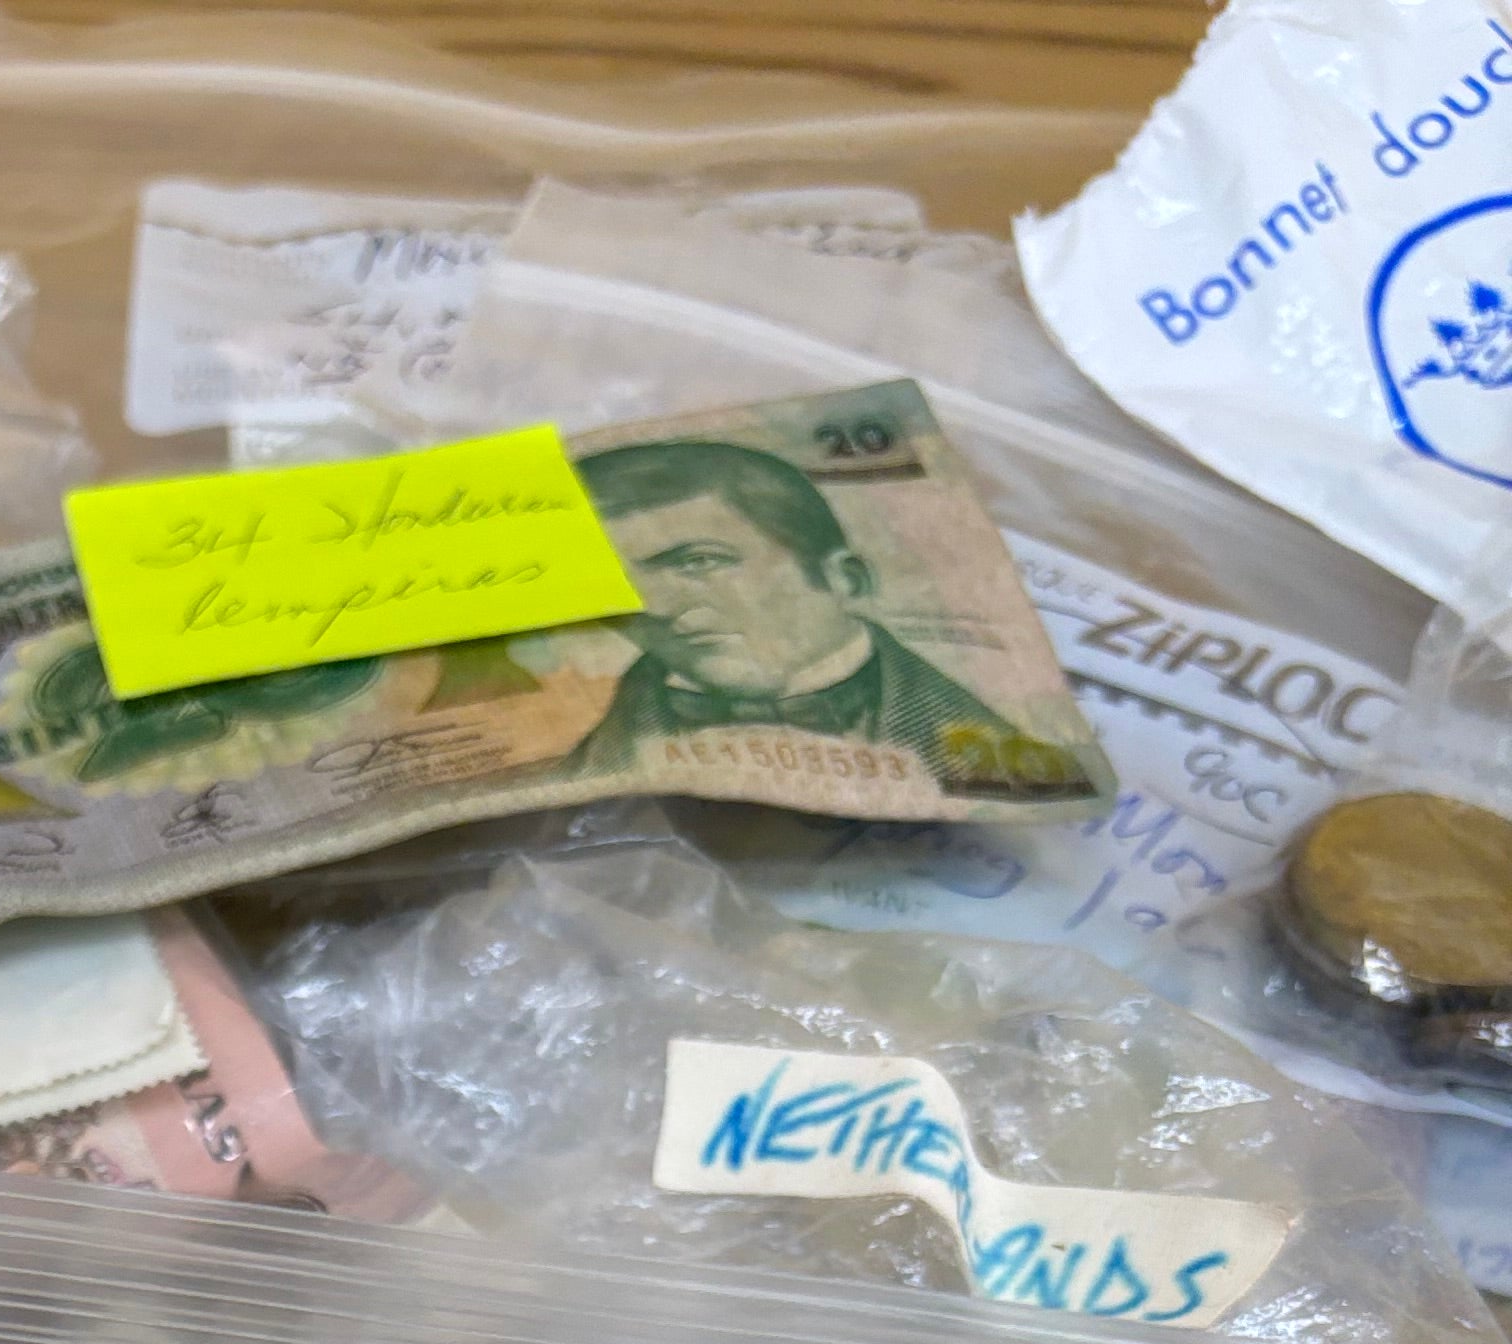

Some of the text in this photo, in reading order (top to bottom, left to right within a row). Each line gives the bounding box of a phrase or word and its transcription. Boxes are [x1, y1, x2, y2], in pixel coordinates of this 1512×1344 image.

[1138, 19, 1512, 346] Bonnet douc
[814, 421, 894, 458] 20
